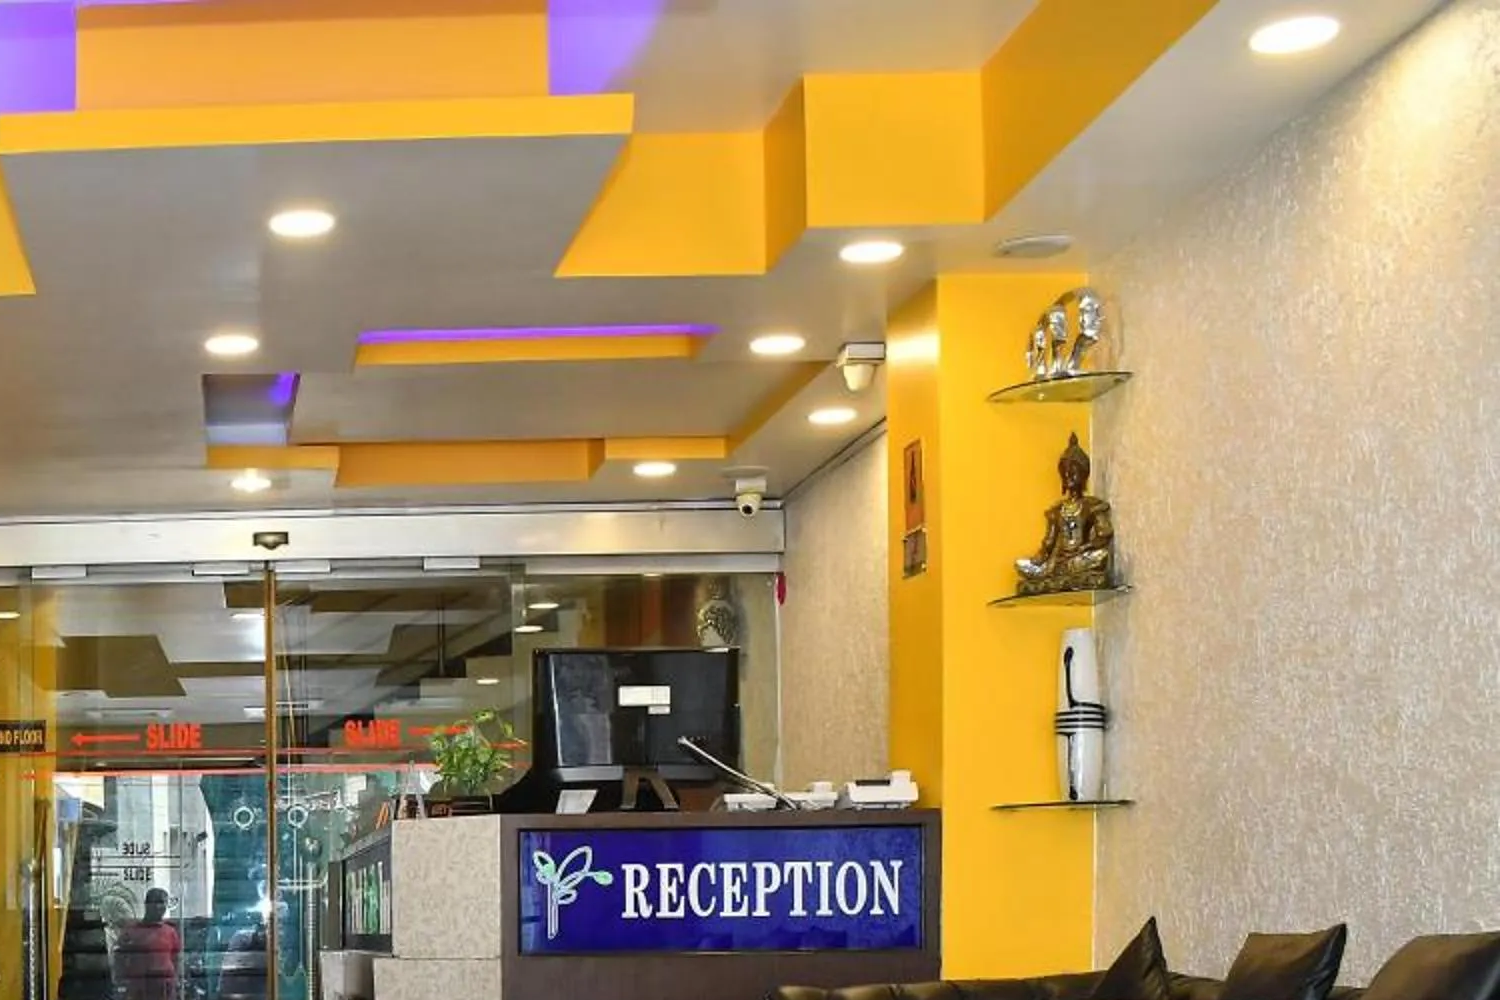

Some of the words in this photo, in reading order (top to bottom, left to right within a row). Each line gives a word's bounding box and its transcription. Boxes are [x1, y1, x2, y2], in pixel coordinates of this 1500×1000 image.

[13, 729, 44, 745] FLOOR
[146, 723, 203, 749] SLIDE
[621, 859, 905, 920] RECEPTION
